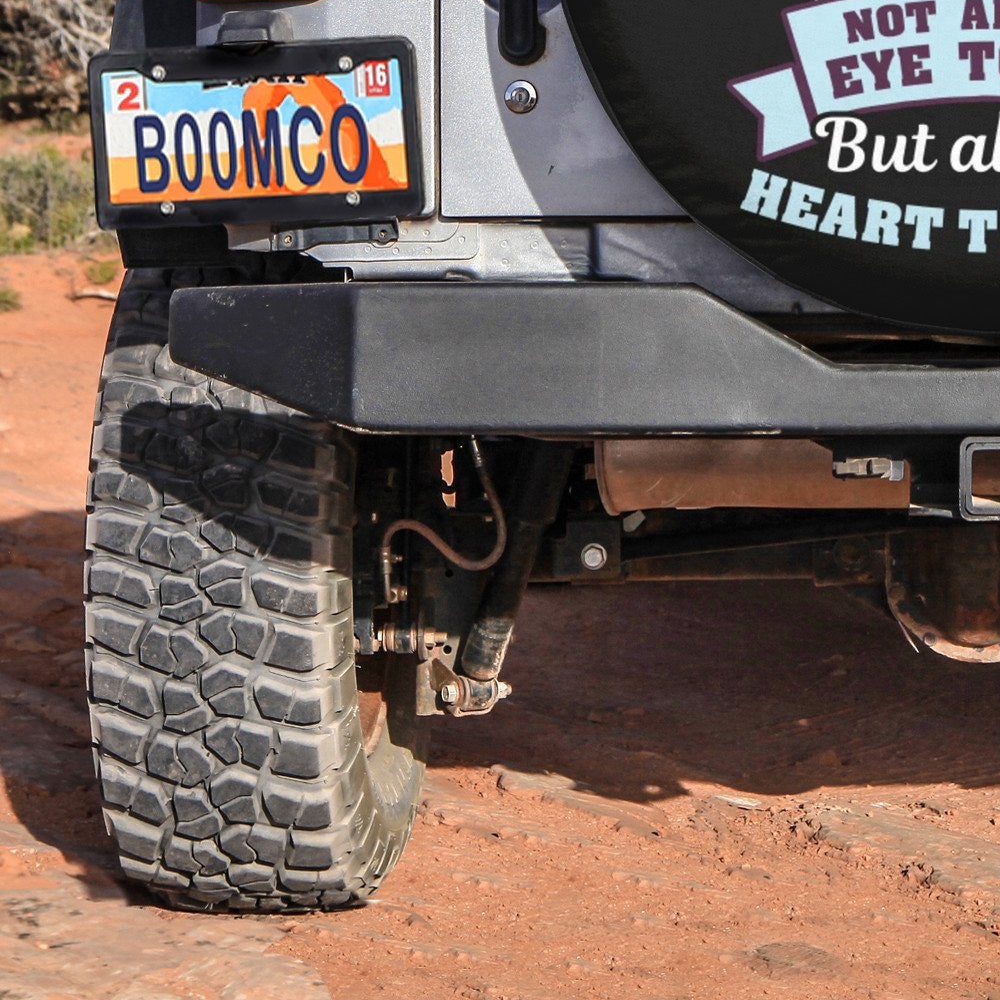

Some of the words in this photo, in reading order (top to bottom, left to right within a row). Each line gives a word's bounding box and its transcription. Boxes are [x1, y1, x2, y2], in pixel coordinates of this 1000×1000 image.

[842, 0, 937, 44] NOT
[116, 81, 141, 111] 2
[365, 63, 387, 87] 16
[825, 44, 933, 100] EYE
[814, 116, 939, 173] But
[740, 168, 945, 251] HEART
